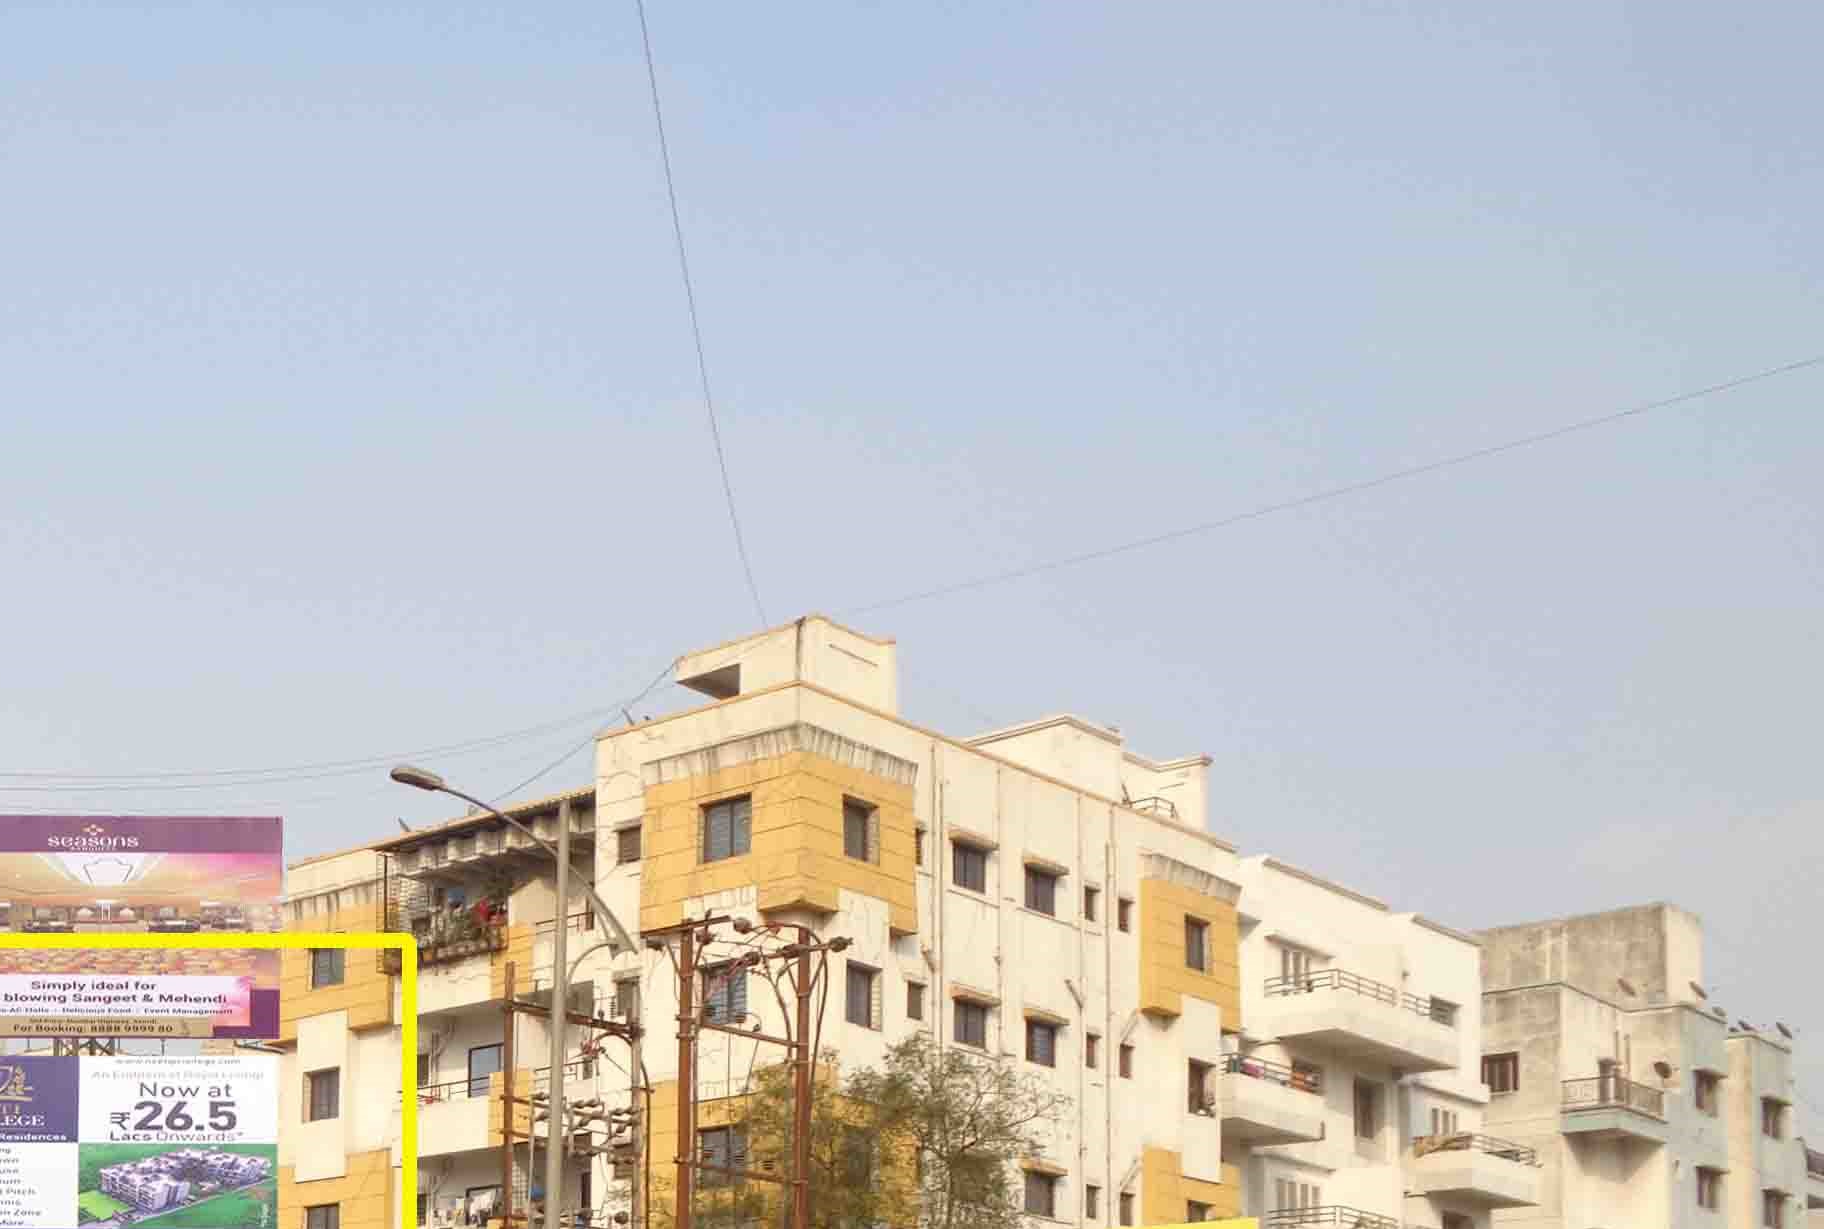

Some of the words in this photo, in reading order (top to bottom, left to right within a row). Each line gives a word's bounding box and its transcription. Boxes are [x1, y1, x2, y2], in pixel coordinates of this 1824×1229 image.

[47, 836, 139, 848] seasons
[31, 980, 85, 992] Simply
[90, 980, 126, 990] ideal
[133, 980, 157, 990] for
[3, 992, 68, 1006] blowing
[72, 993, 137, 1006] Sangeet
[142, 993, 153, 1003] &
[158, 993, 227, 1004] Mehendi
[13, 1024, 32, 1033] For
[35, 1024, 88, 1034] Booking:
[139, 1082, 200, 1097] Now
[207, 1083, 232, 1098] at
[110, 1100, 237, 1131] ₹26.5
[109, 1131, 152, 1142] Lacs
